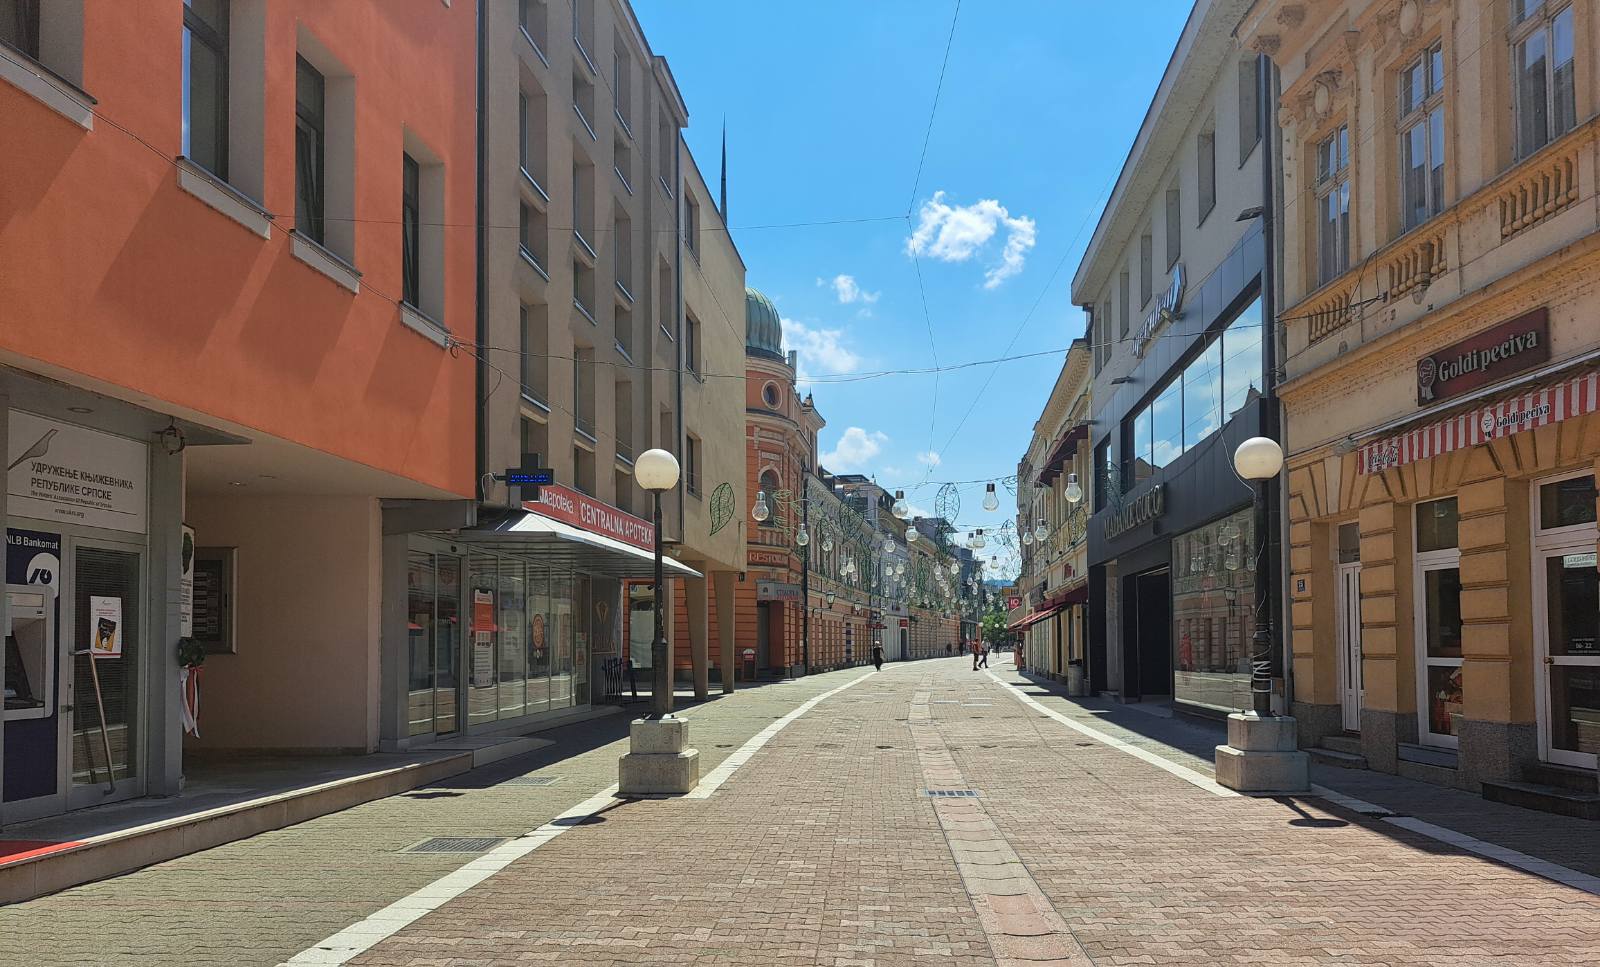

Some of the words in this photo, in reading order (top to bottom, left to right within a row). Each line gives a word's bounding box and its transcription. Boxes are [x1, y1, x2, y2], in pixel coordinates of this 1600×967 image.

[1438, 349, 1479, 382] Goldi
[1481, 331, 1538, 372] peciva
[1496, 411, 1518, 428] Goldi
[1520, 404, 1550, 423] peciva
[31, 461, 79, 480] УДРУЖЕЊЕ
[80, 470, 134, 490] КЊИЖЕВНИКА
[31, 477, 80, 495] РЕПУБЛИКЕ
[81, 486, 112, 501] СРПСКЕ
[6, 534, 22, 545] NLB
[23, 536, 58, 549] Bankomat
